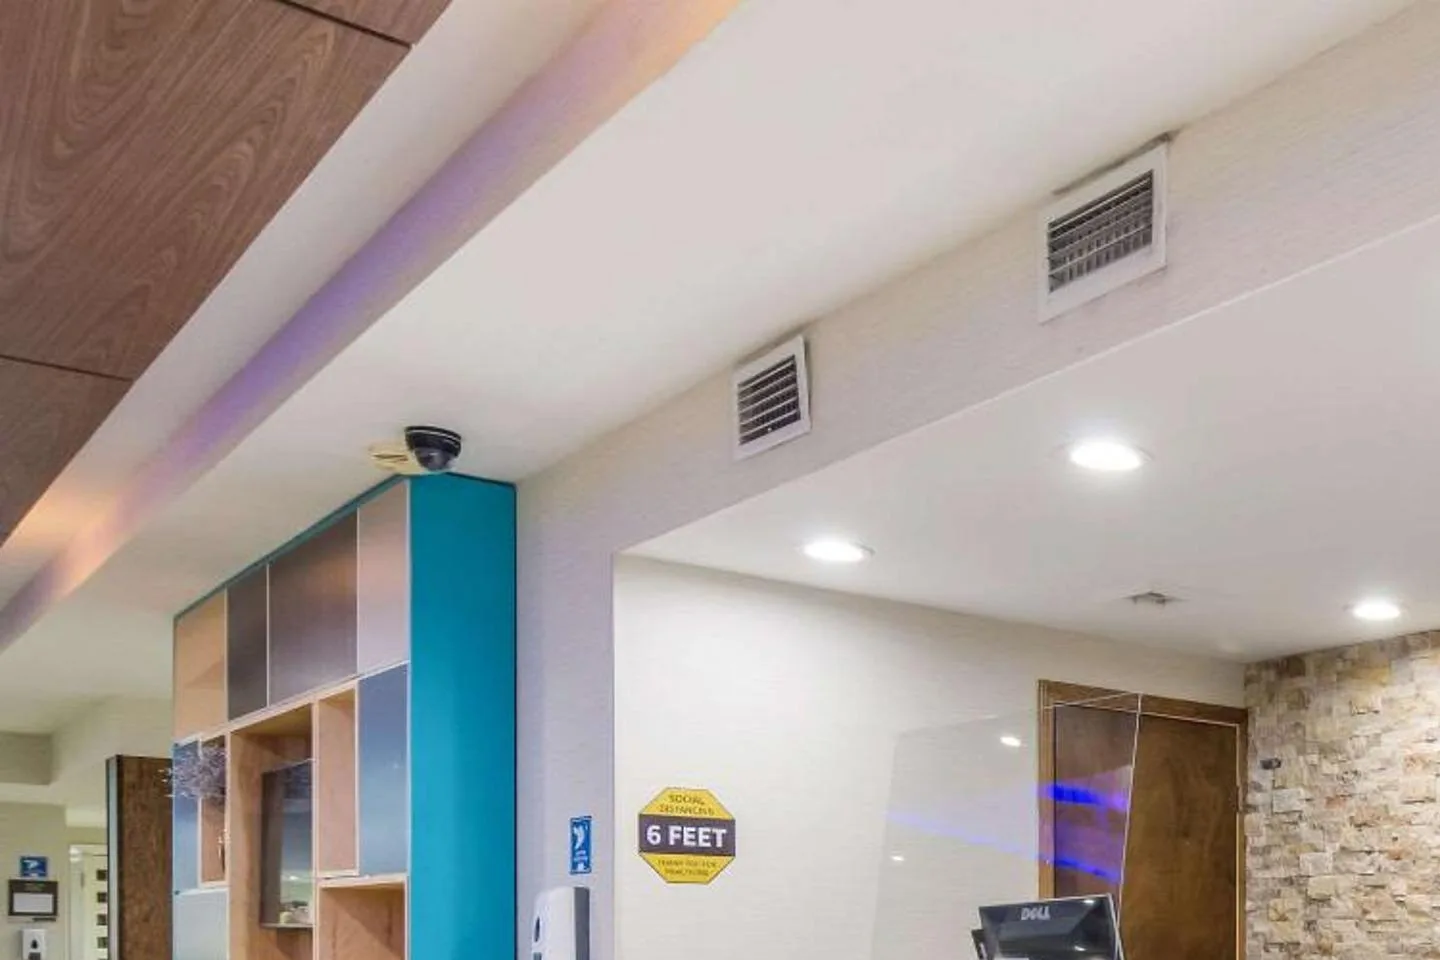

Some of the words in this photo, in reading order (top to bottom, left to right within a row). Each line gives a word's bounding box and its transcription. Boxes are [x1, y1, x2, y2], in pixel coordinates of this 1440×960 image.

[646, 825, 661, 846] 6
[668, 825, 728, 848] FEET
[1021, 906, 1051, 921] DELL
